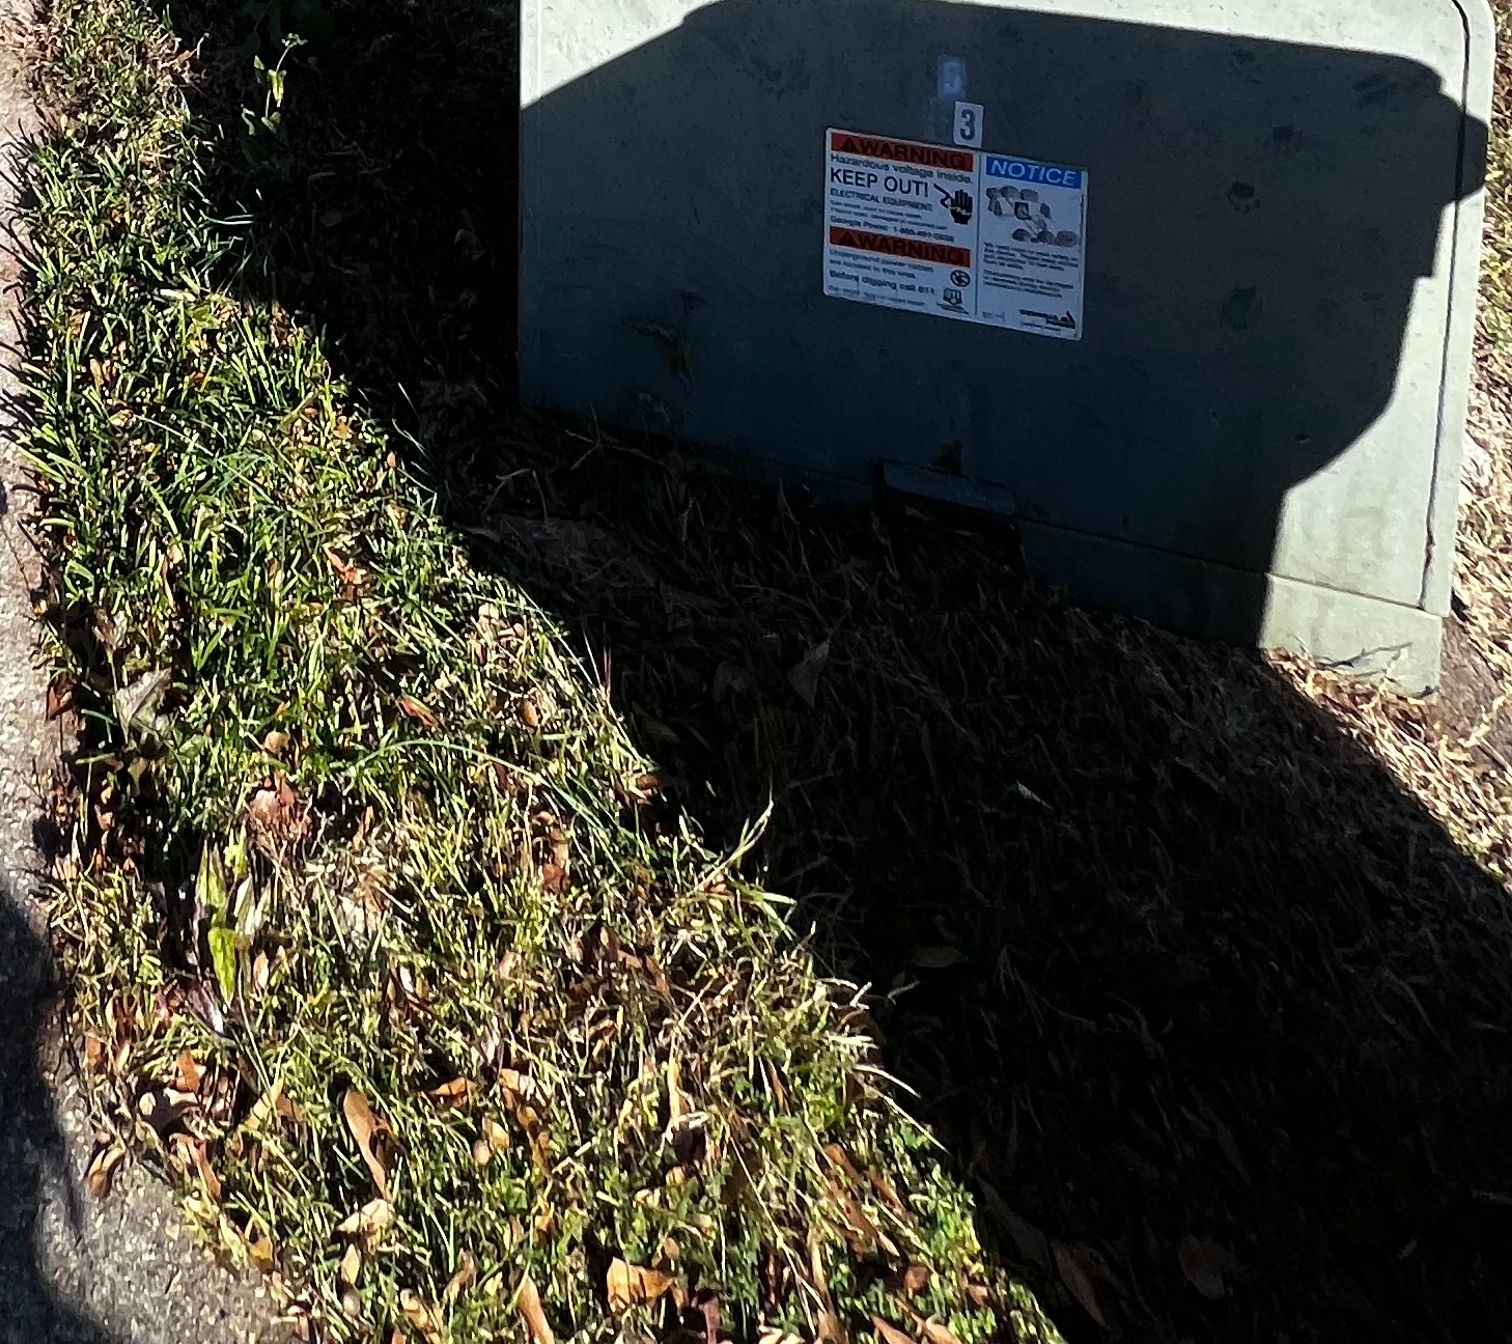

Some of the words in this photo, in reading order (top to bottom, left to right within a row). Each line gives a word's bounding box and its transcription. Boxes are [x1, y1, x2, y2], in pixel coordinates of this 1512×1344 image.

[960, 109, 976, 141] 3
[830, 153, 890, 172] Hazardous
[893, 165, 934, 179] voltage
[858, 139, 962, 169] WARNING
[830, 167, 878, 188] KEEP
[884, 176, 929, 198] OUT!
[991, 159, 1077, 186] NOTICE
[830, 188, 881, 203] ELECTRICAL
[830, 215, 862, 228] Georgia
[857, 233, 963, 264] WARNING
